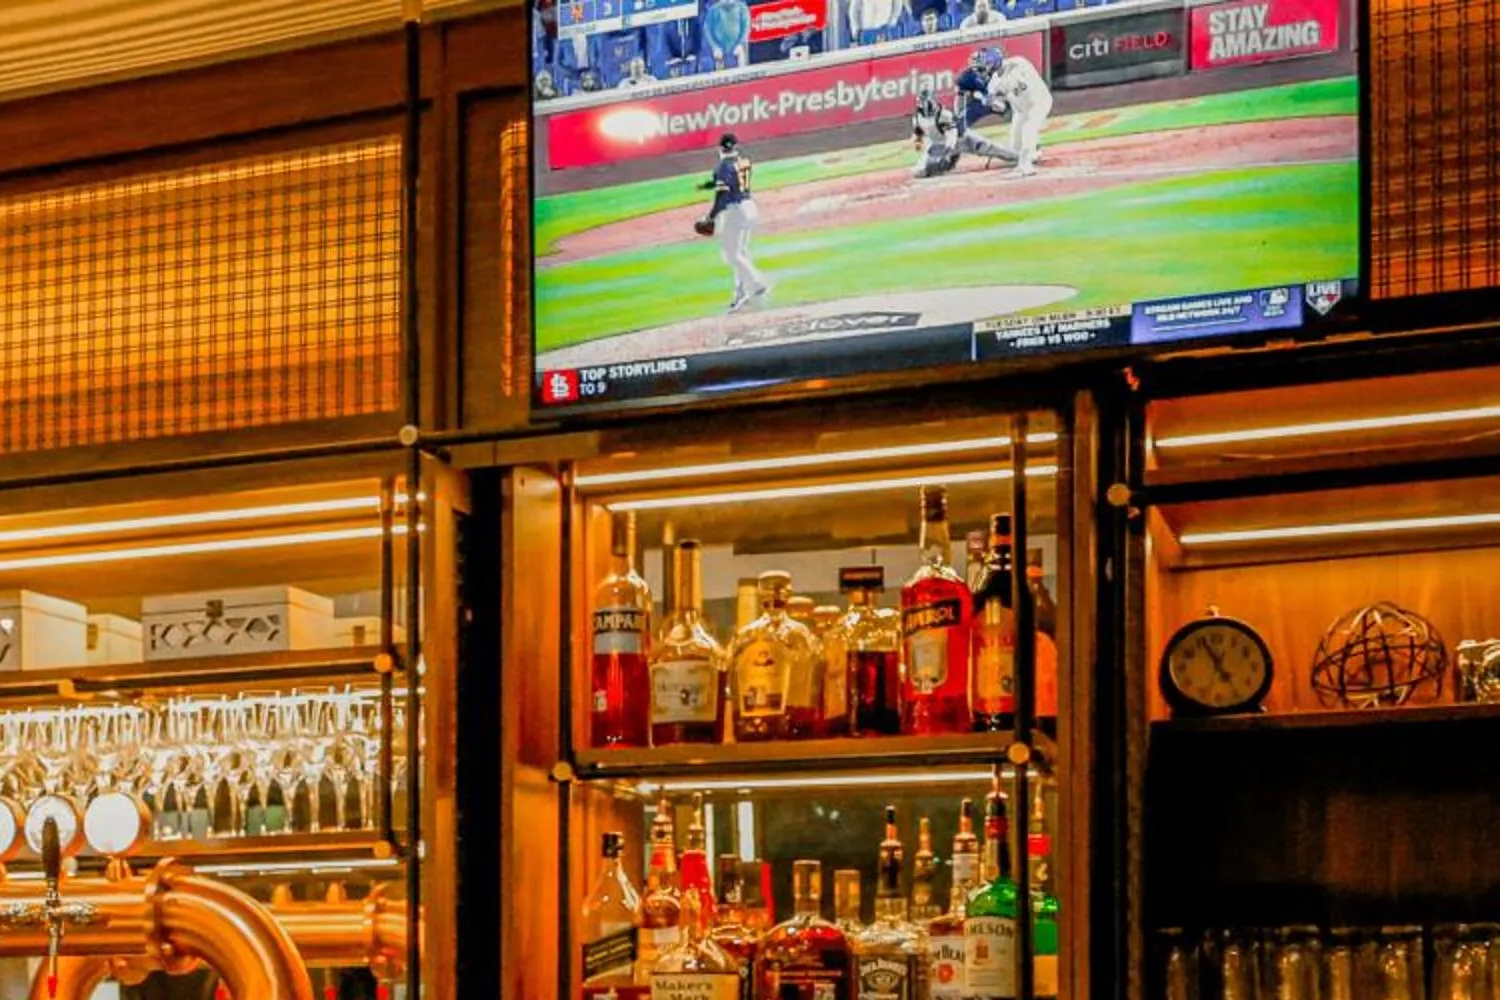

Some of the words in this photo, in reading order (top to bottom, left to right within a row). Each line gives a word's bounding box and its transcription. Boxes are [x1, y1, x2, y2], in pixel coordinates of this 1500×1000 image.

[1209, 4, 1269, 34] STAY
[1113, 31, 1168, 52] FIELD
[1208, 20, 1320, 62] AMAZING
[580, 365, 606, 382] TOP
[608, 357, 688, 380] STORYLINES
[580, 382, 596, 396] TO
